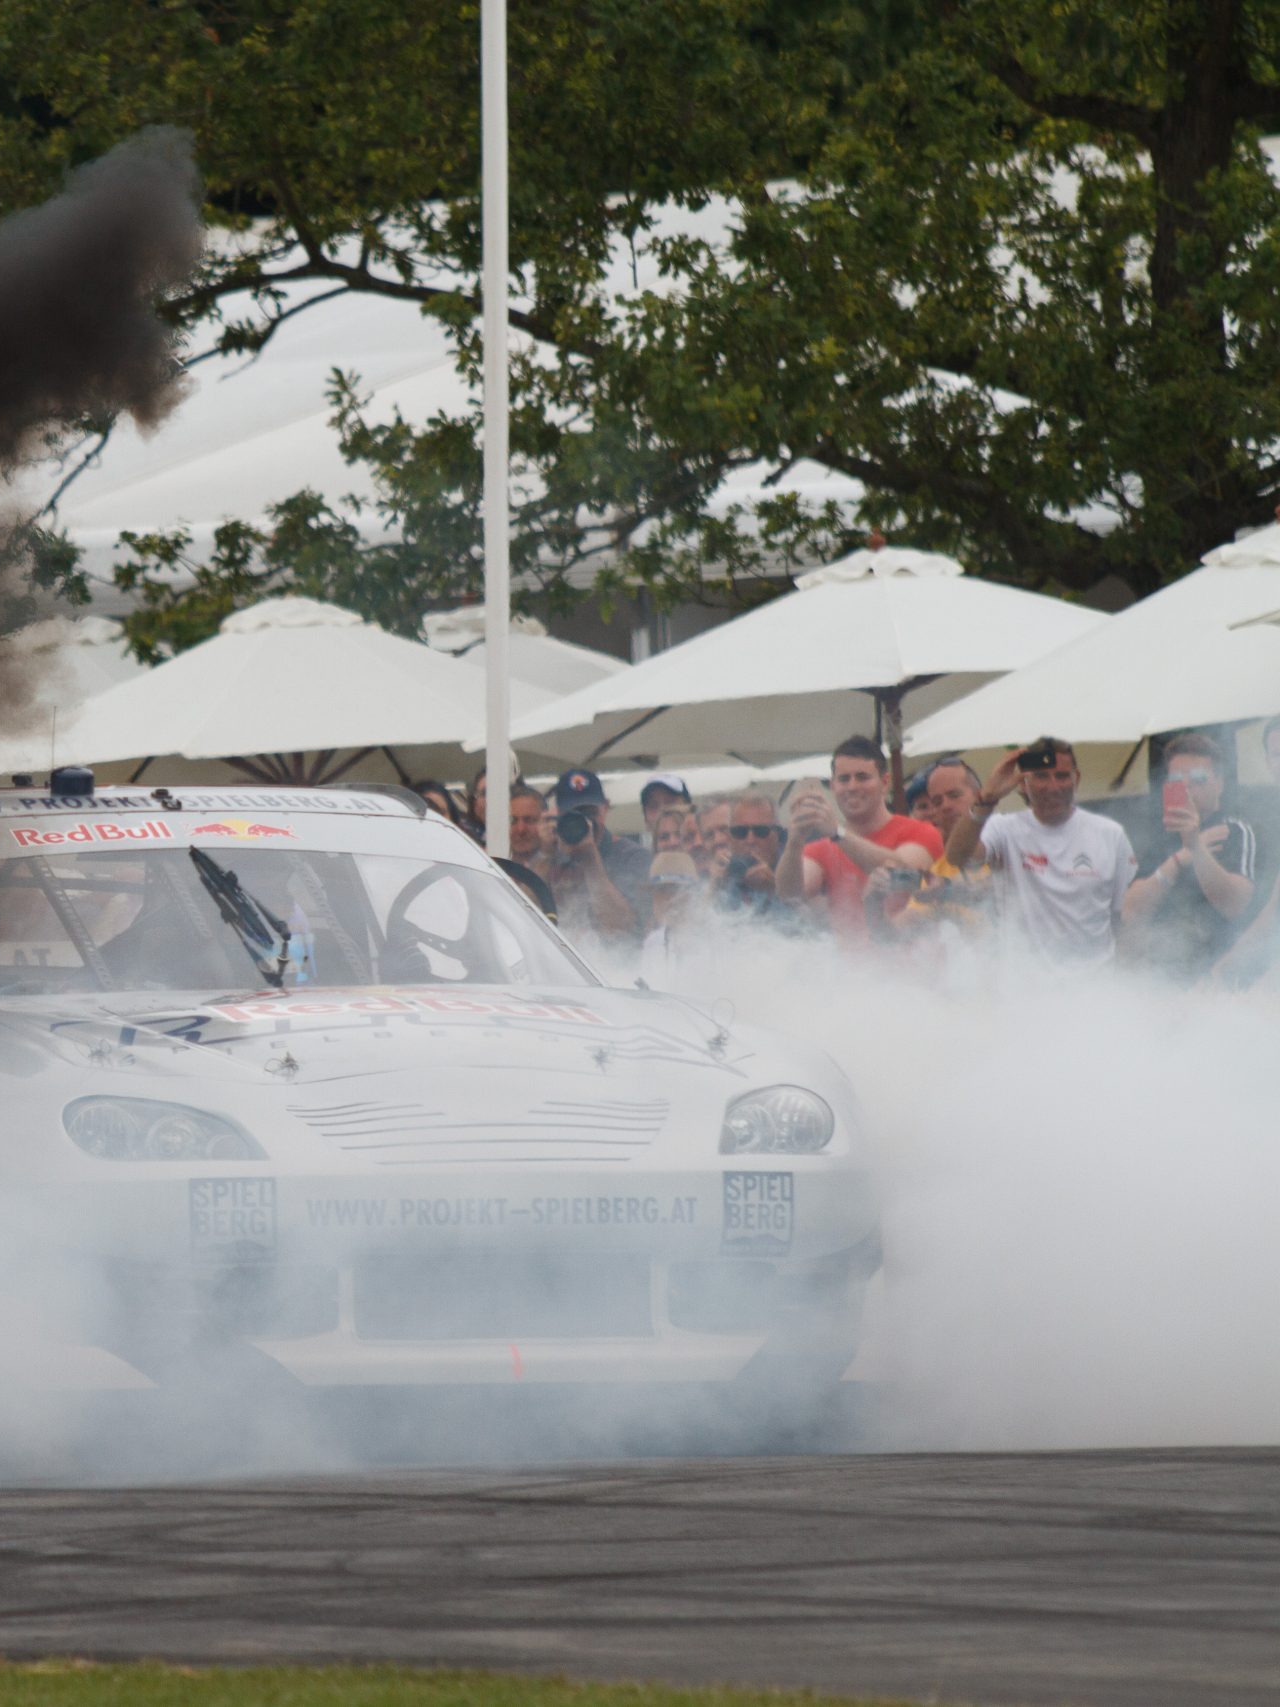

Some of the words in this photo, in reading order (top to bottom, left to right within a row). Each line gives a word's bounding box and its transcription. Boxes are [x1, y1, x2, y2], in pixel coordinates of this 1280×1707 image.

[12, 823, 94, 847] Red
[95, 821, 172, 841] Bull
[217, 997, 408, 1021] Red
[416, 998, 610, 1025] Bull
[193, 1180, 276, 1207] SPIEL
[727, 1174, 793, 1201] SPIEL
[193, 1209, 267, 1236] BERG
[306, 1196, 698, 1226] WWW.PROJEKT-SPIELBERG.AT
[727, 1203, 786, 1230] BERG
